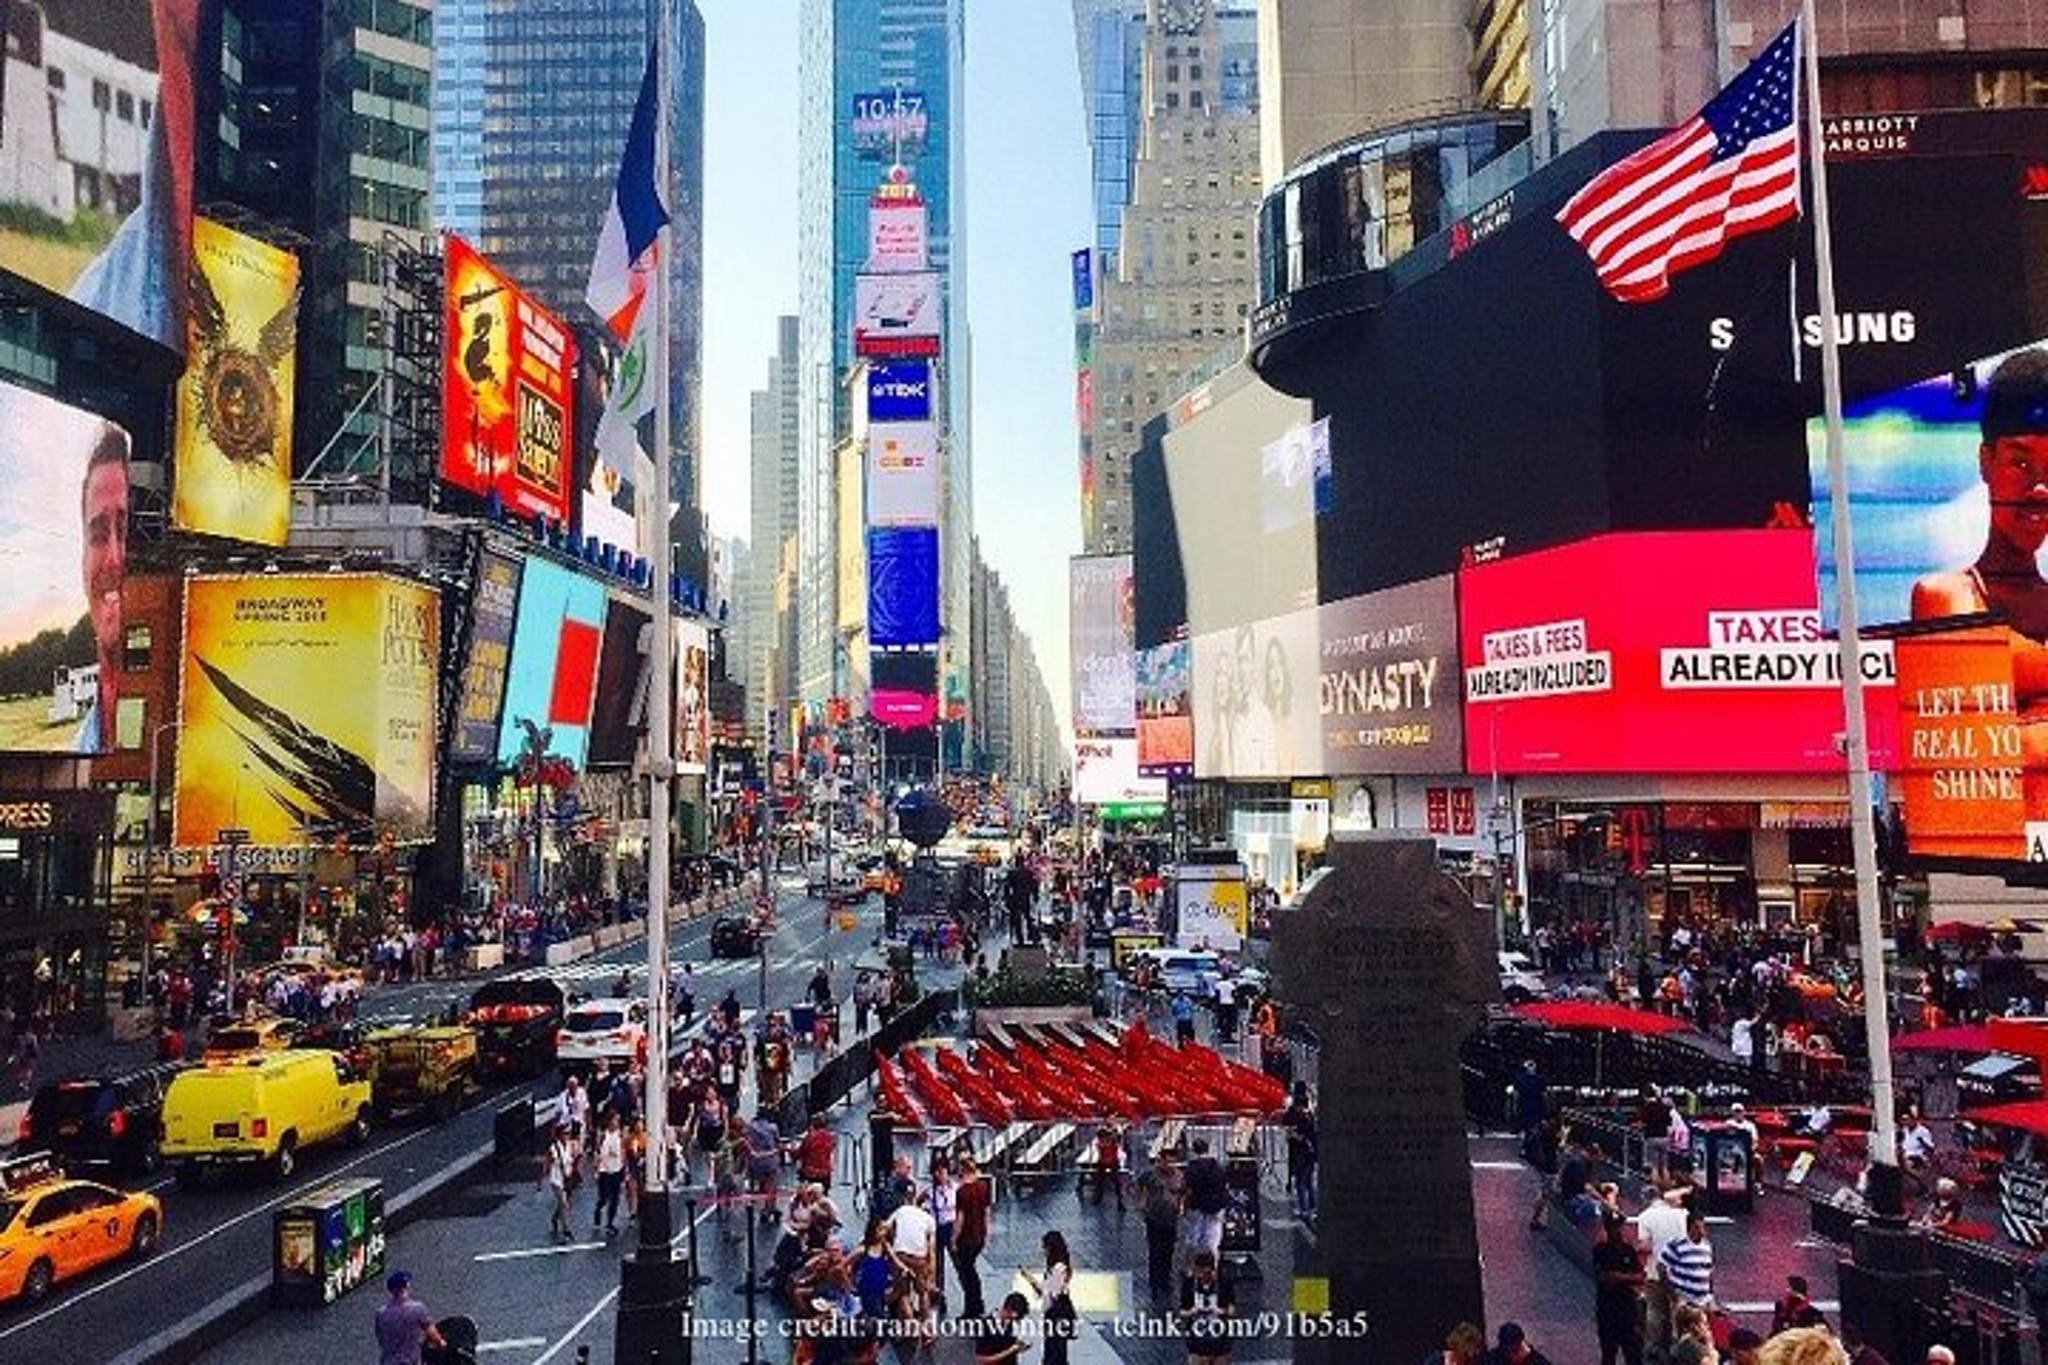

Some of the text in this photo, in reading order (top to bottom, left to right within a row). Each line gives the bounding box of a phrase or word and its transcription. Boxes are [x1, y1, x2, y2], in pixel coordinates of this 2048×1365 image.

[857, 98, 922, 119] 10:57
[1821, 135, 1908, 152] ARQUIS
[234, 611, 290, 623] SPRING
[236, 597, 327, 611] BROADWAY
[1487, 631, 1530, 661] TAXES
[1546, 625, 1583, 653] FEES
[1711, 616, 1819, 643] TAXES
[1470, 659, 1606, 698] ALREADY INCLUDED
[1669, 653, 1817, 681] ALREADY
[1320, 657, 1438, 715] DYNASTY
[1917, 687, 1964, 717] LET
[1912, 728, 1977, 760] REAL
[0, 802, 50, 828] PRESS
